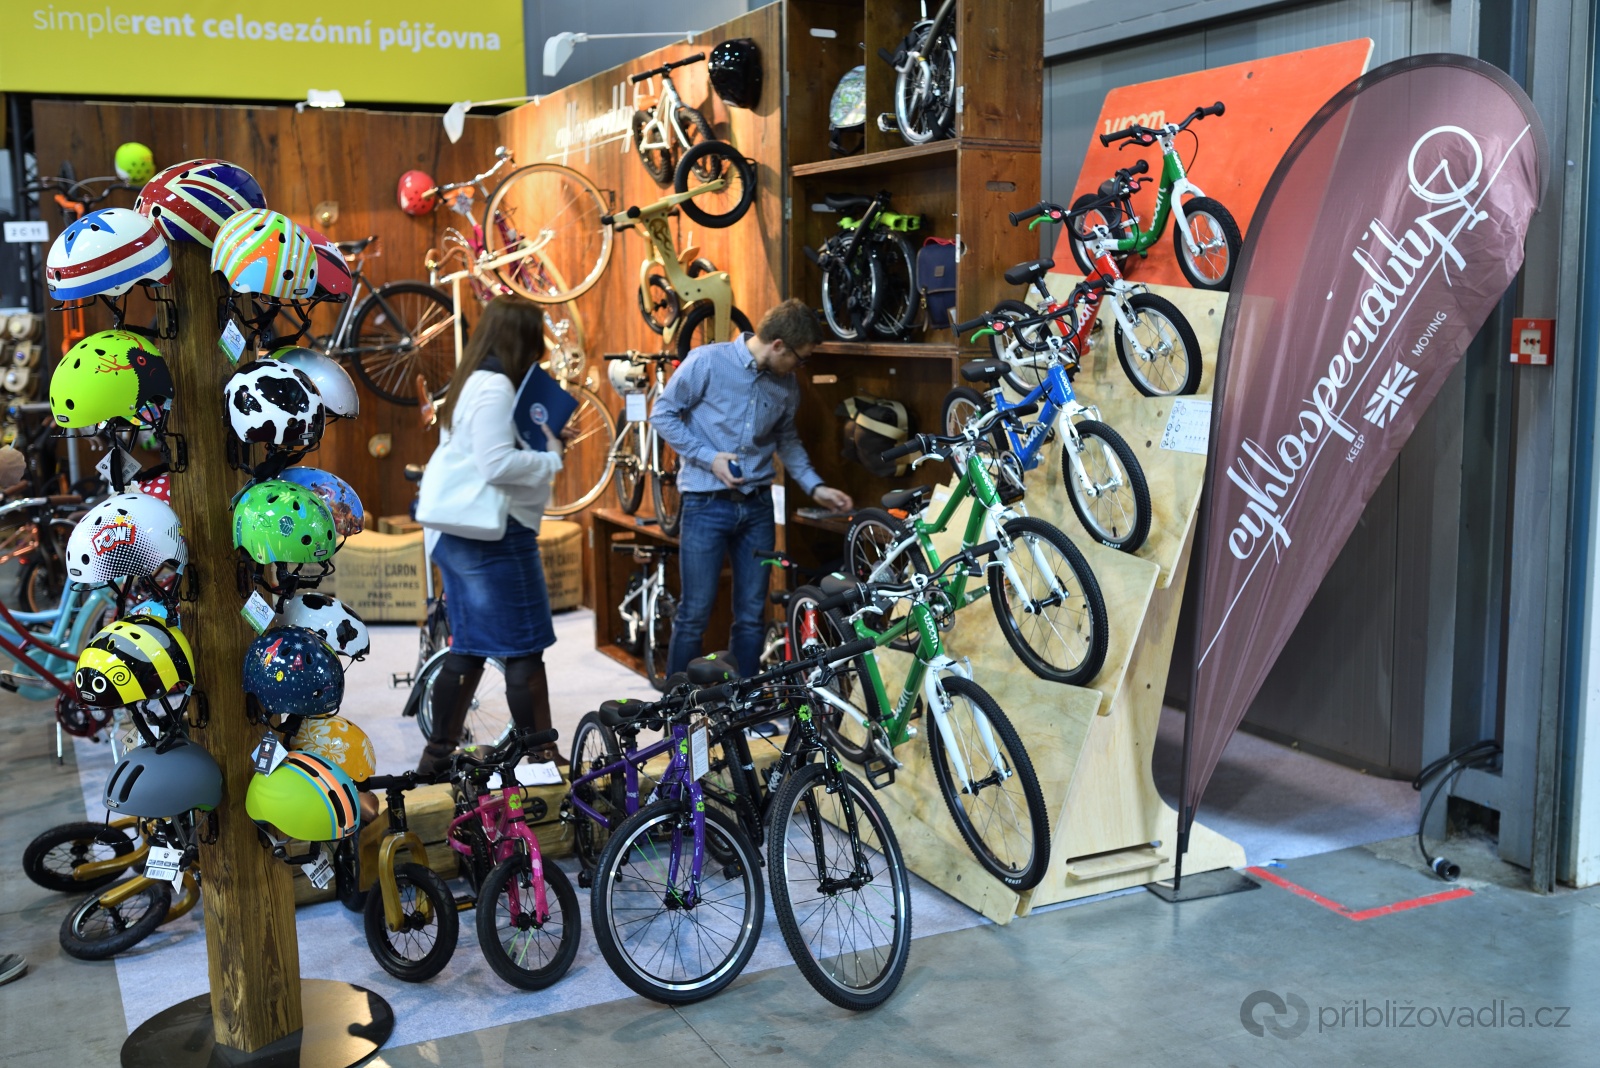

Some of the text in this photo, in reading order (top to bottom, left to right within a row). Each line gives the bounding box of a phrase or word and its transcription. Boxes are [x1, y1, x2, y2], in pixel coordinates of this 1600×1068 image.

[33, 4, 501, 53] simplerent celosezónní půjčovna
[1060, 370, 1072, 396] woom
[1346, 311, 1447, 463] KEEP MOVING
[93, 526, 131, 552] POW!
[385, 564, 417, 577] CARON
[923, 611, 939, 650] woom
